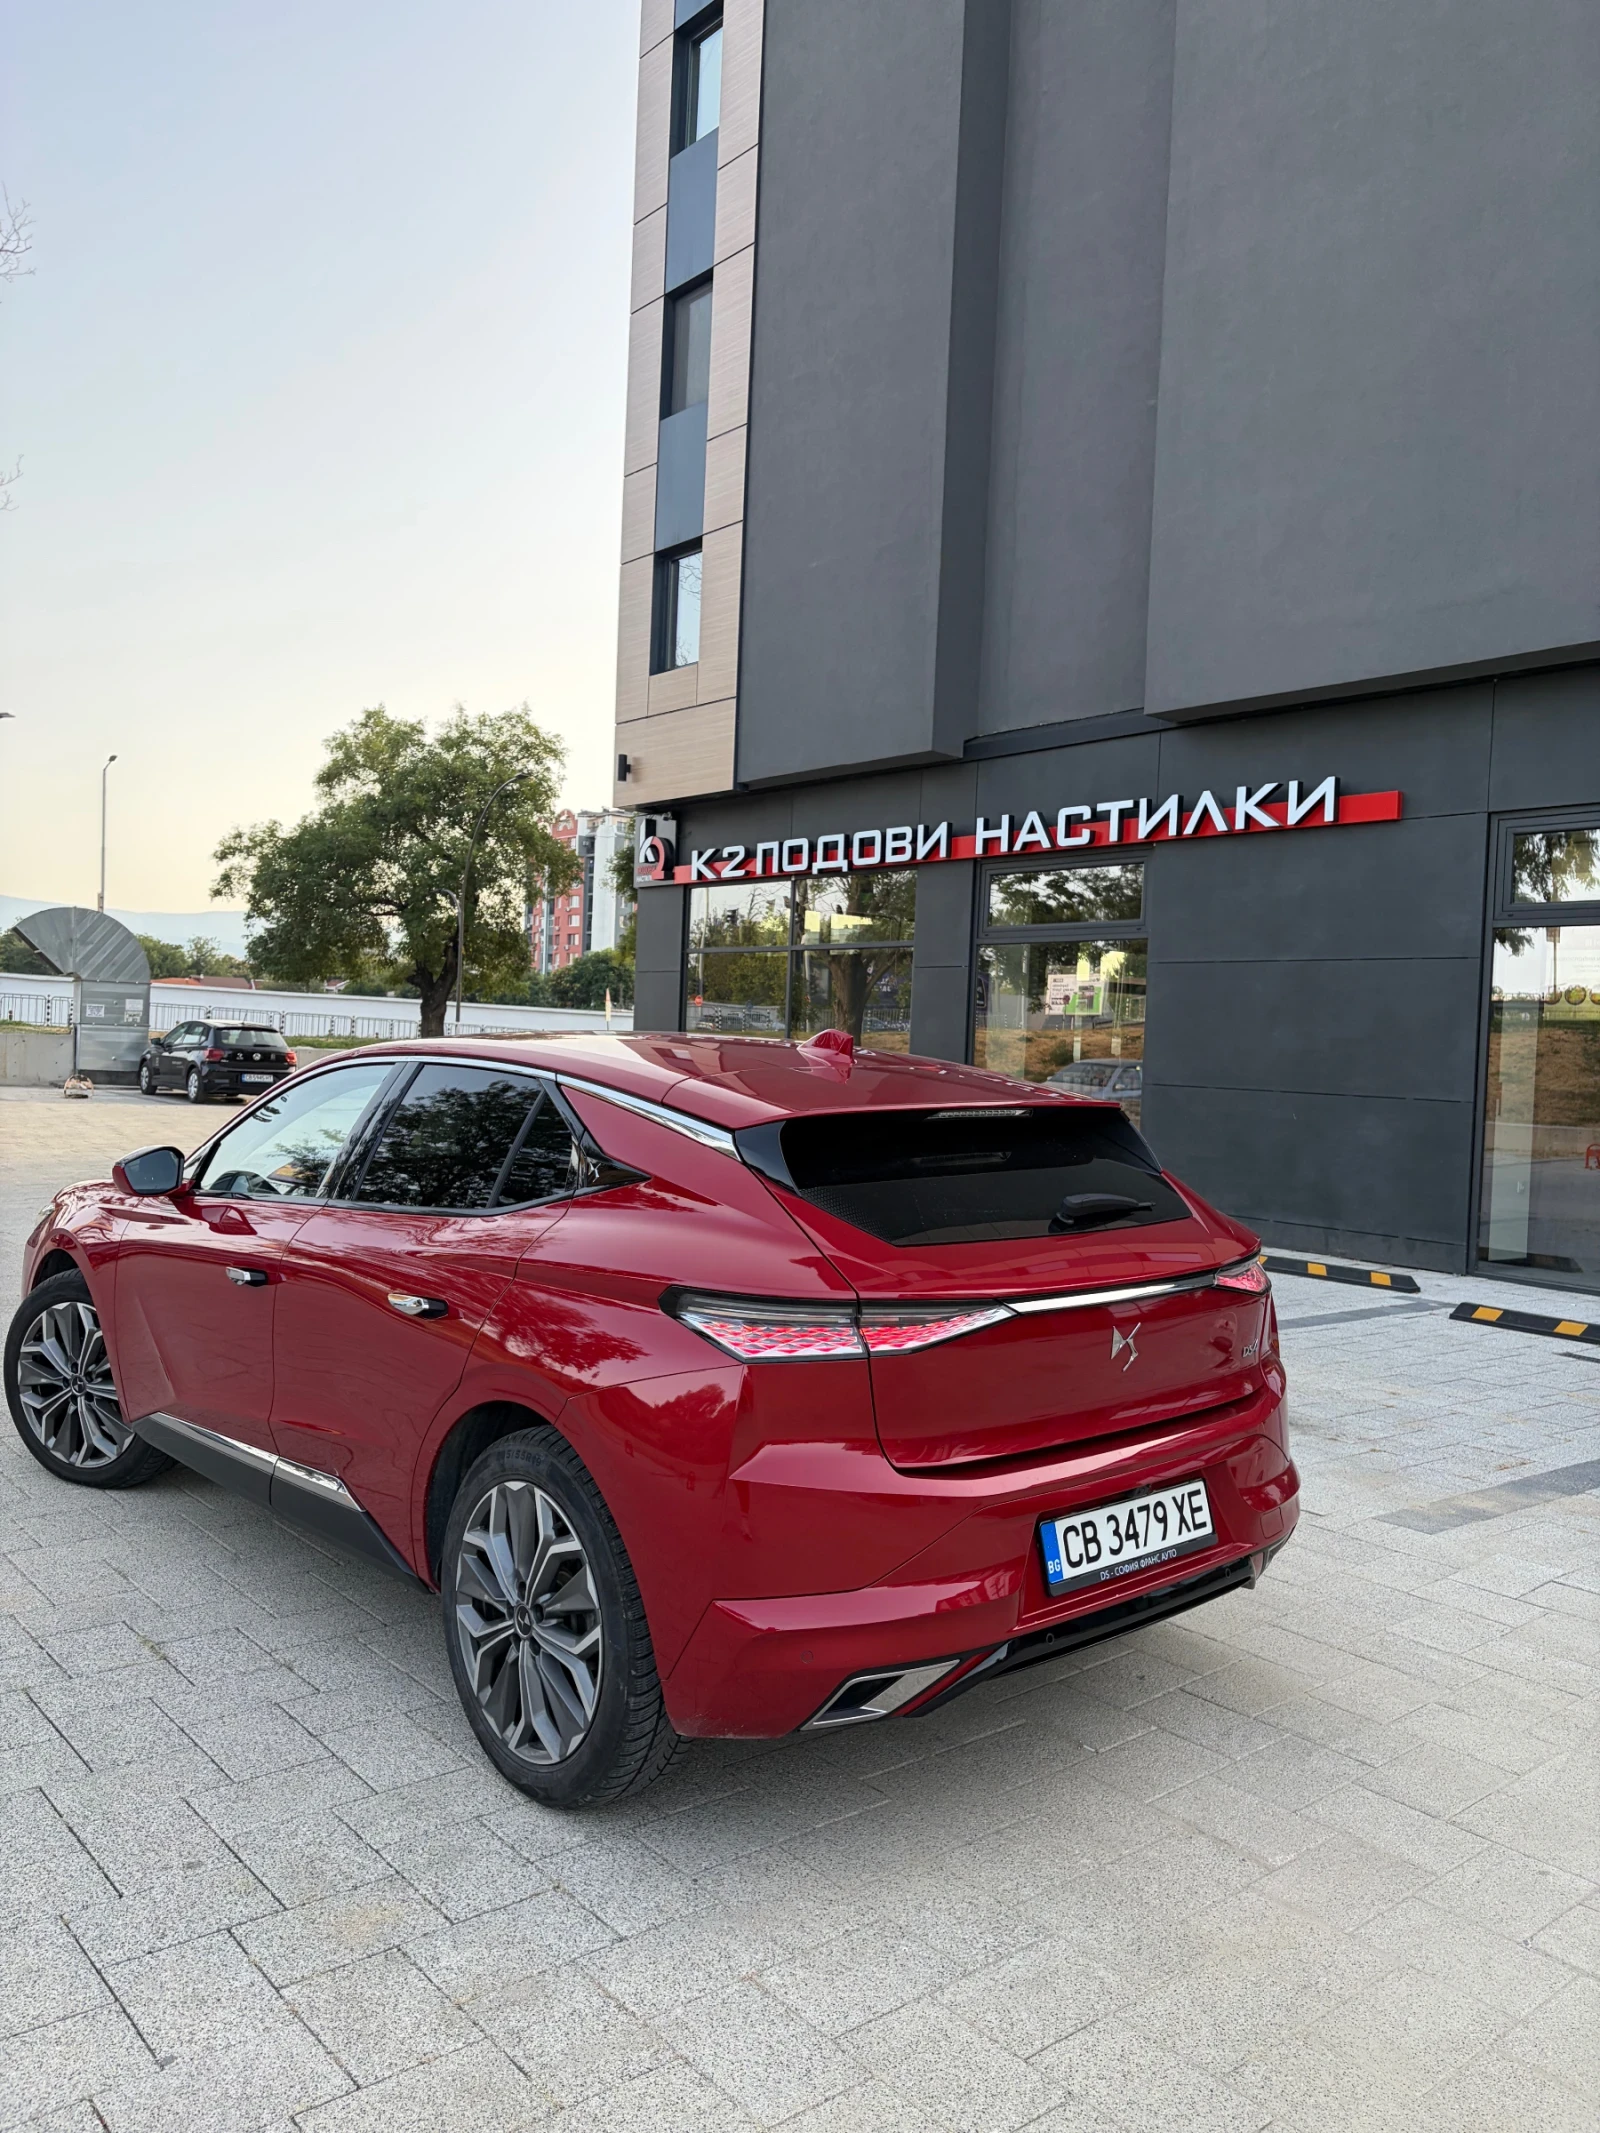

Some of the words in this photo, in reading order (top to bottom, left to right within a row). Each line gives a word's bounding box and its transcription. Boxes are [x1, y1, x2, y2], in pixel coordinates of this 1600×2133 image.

[756, 821, 948, 875] ПОДОВИ
[975, 775, 1336, 855] НАСТИЛКИ
[1106, 1500, 1168, 1556] 3479
[1047, 1560, 1061, 1574] BG
[1114, 1561, 1140, 1576] СОФИЯ
[1161, 1549, 1177, 1562] АУТО
